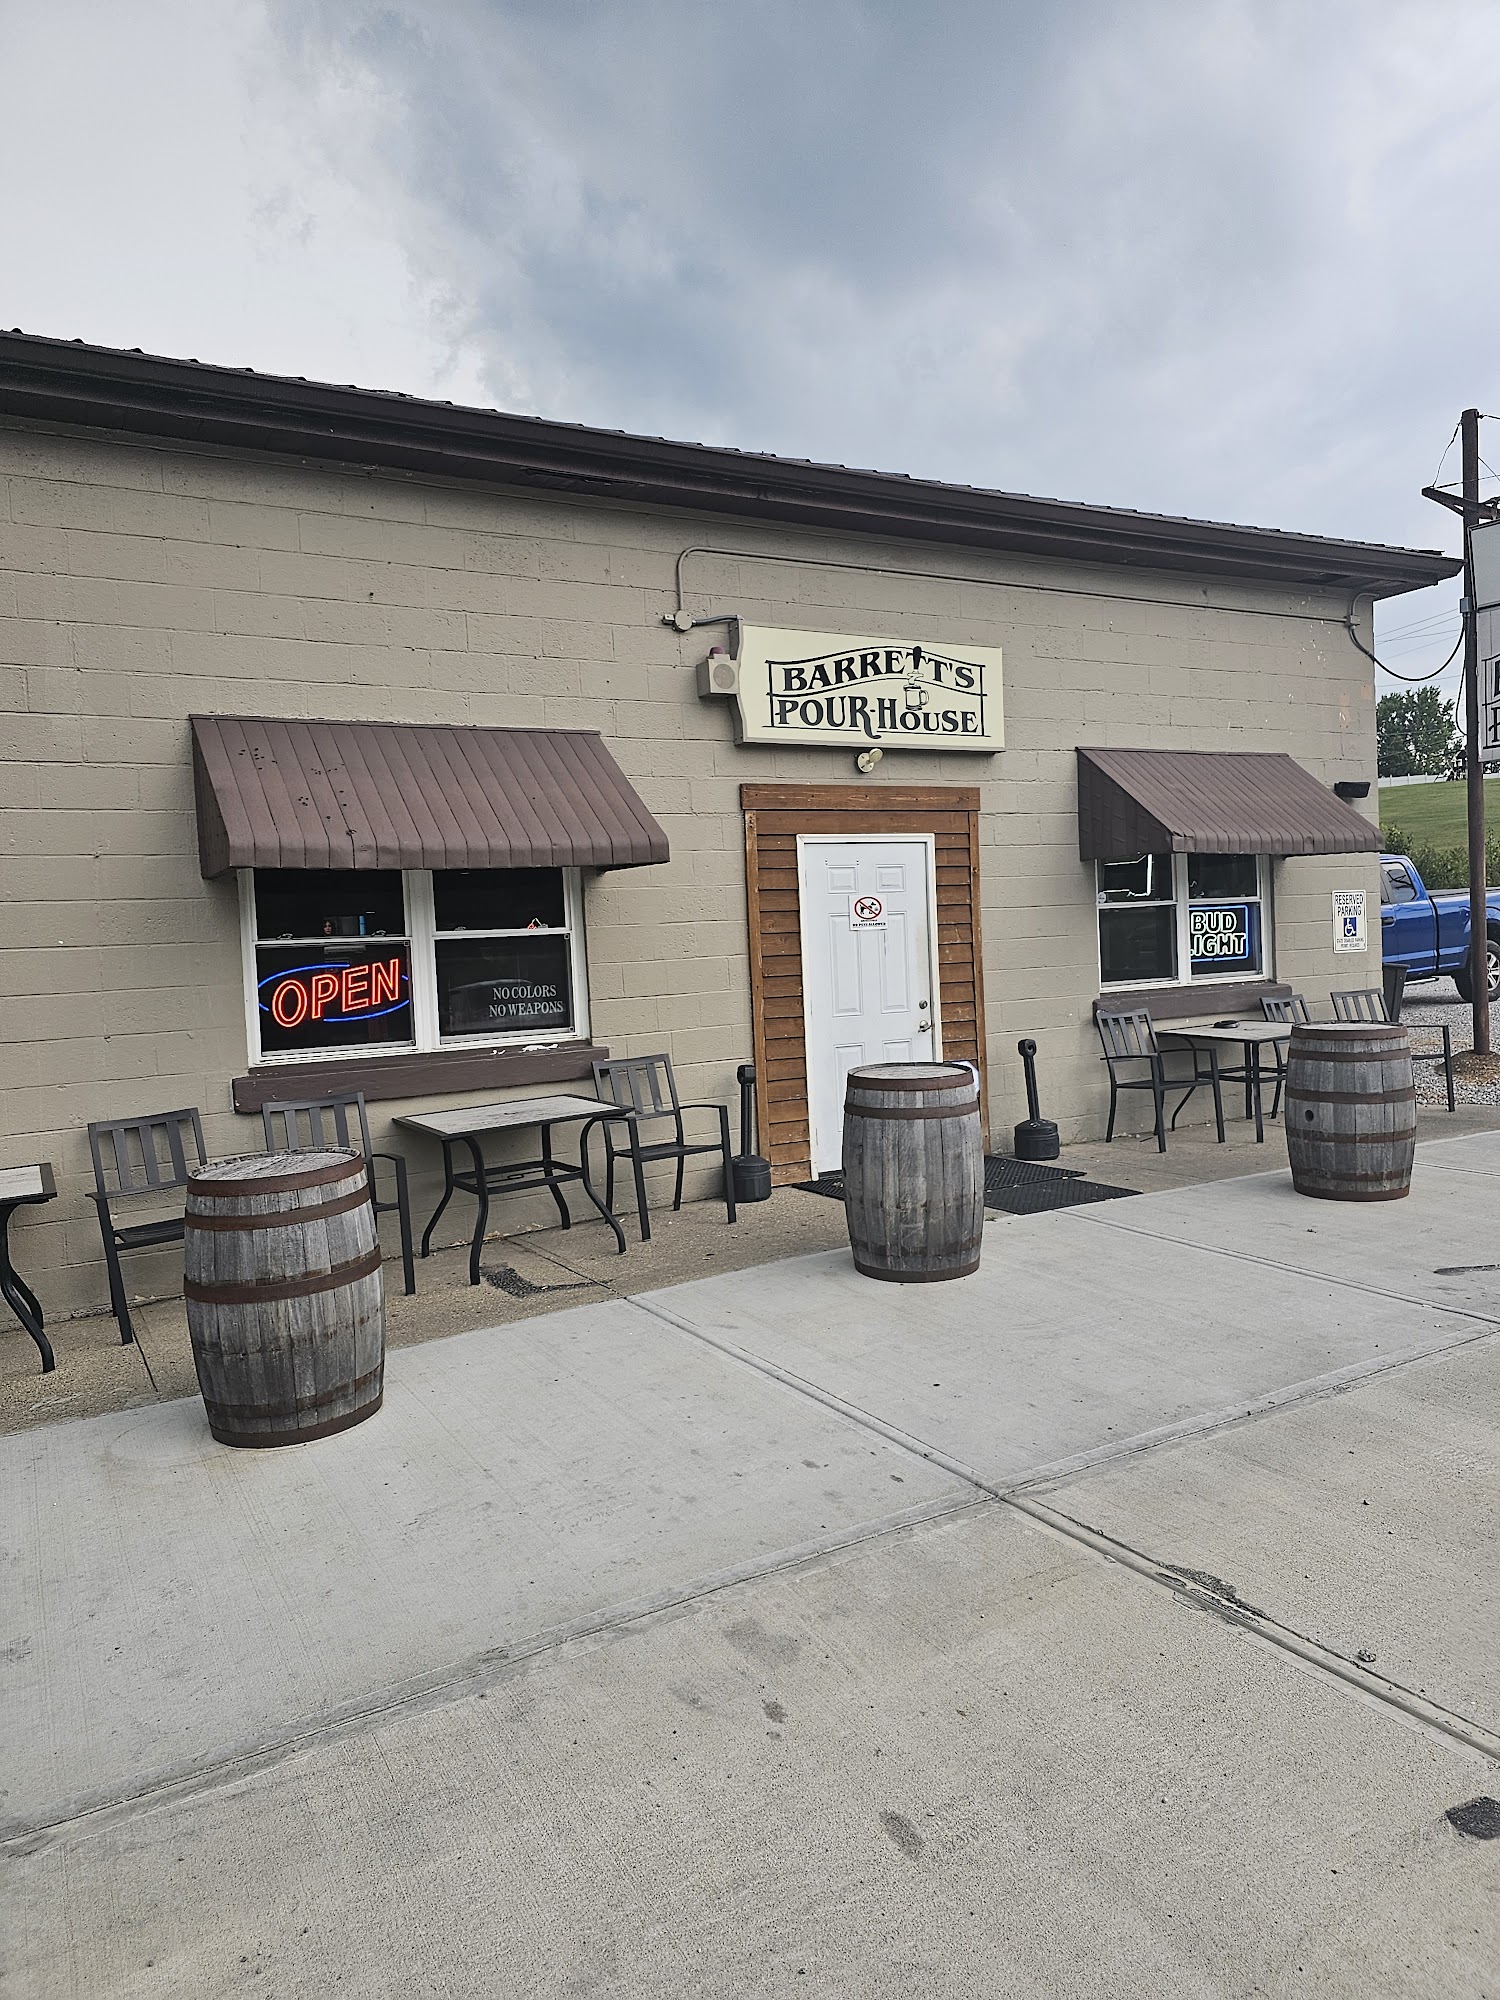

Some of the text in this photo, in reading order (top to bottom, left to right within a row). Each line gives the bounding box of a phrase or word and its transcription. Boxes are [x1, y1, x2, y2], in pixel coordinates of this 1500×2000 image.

[782, 648, 976, 692] BARRETT'S
[1335, 894, 1364, 905] RESERVED
[1337, 905, 1362, 917] PARKING
[1191, 912, 1237, 934] BUD
[1190, 933, 1246, 957] IGHT
[271, 958, 400, 1028] OPEN
[493, 984, 557, 1000] NO COLORS
[489, 1000, 564, 1017] NO WEAPONS
